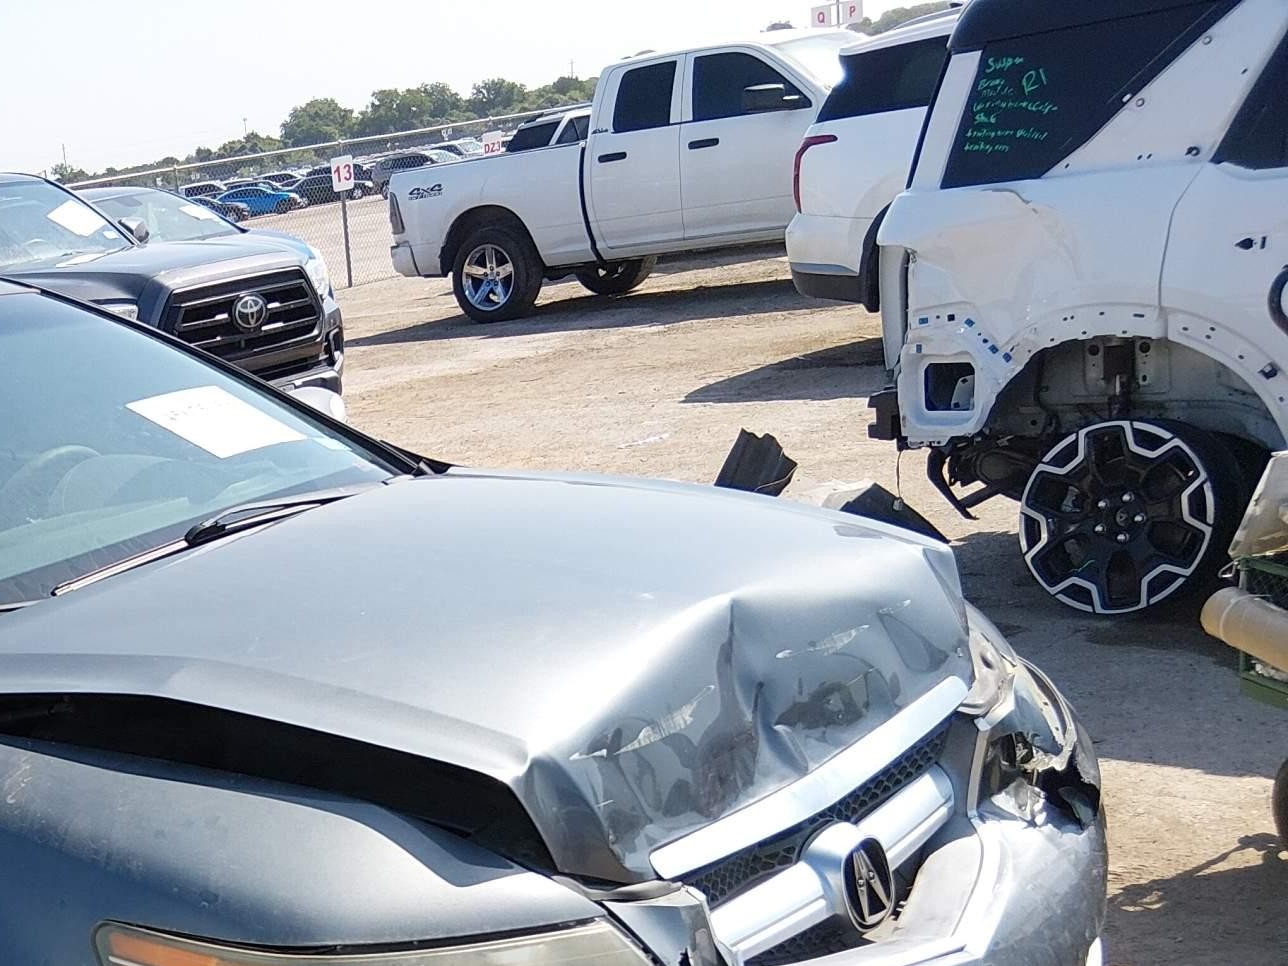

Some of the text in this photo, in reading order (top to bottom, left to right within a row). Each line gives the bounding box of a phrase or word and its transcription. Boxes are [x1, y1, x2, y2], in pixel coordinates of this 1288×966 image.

[817, 11, 825, 24] Q
[849, 5, 856, 17] P
[333, 163, 352, 183] 13
